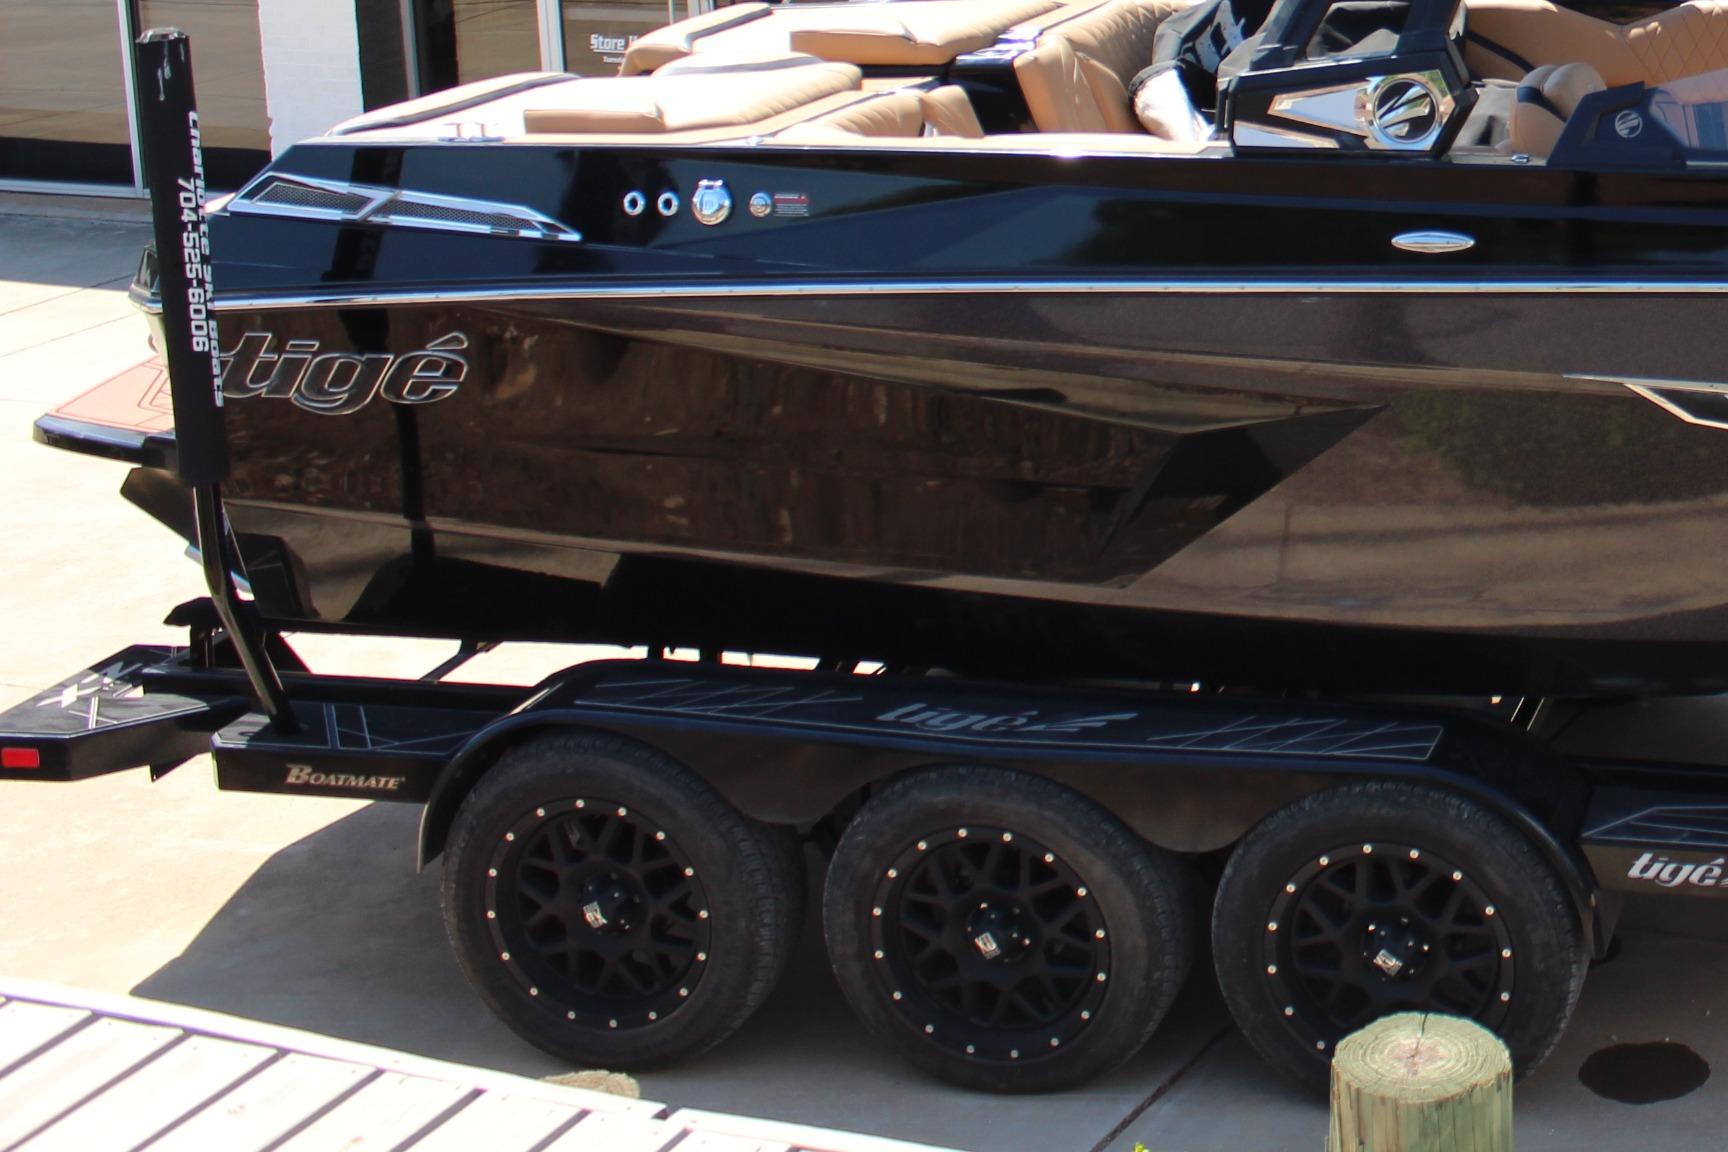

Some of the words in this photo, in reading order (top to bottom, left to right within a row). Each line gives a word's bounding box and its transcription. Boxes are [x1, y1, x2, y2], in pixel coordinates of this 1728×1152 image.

[590, 33, 625, 50] Store
[177, 177, 210, 352] 704-525-6006
[1627, 852, 1725, 888] tigé
